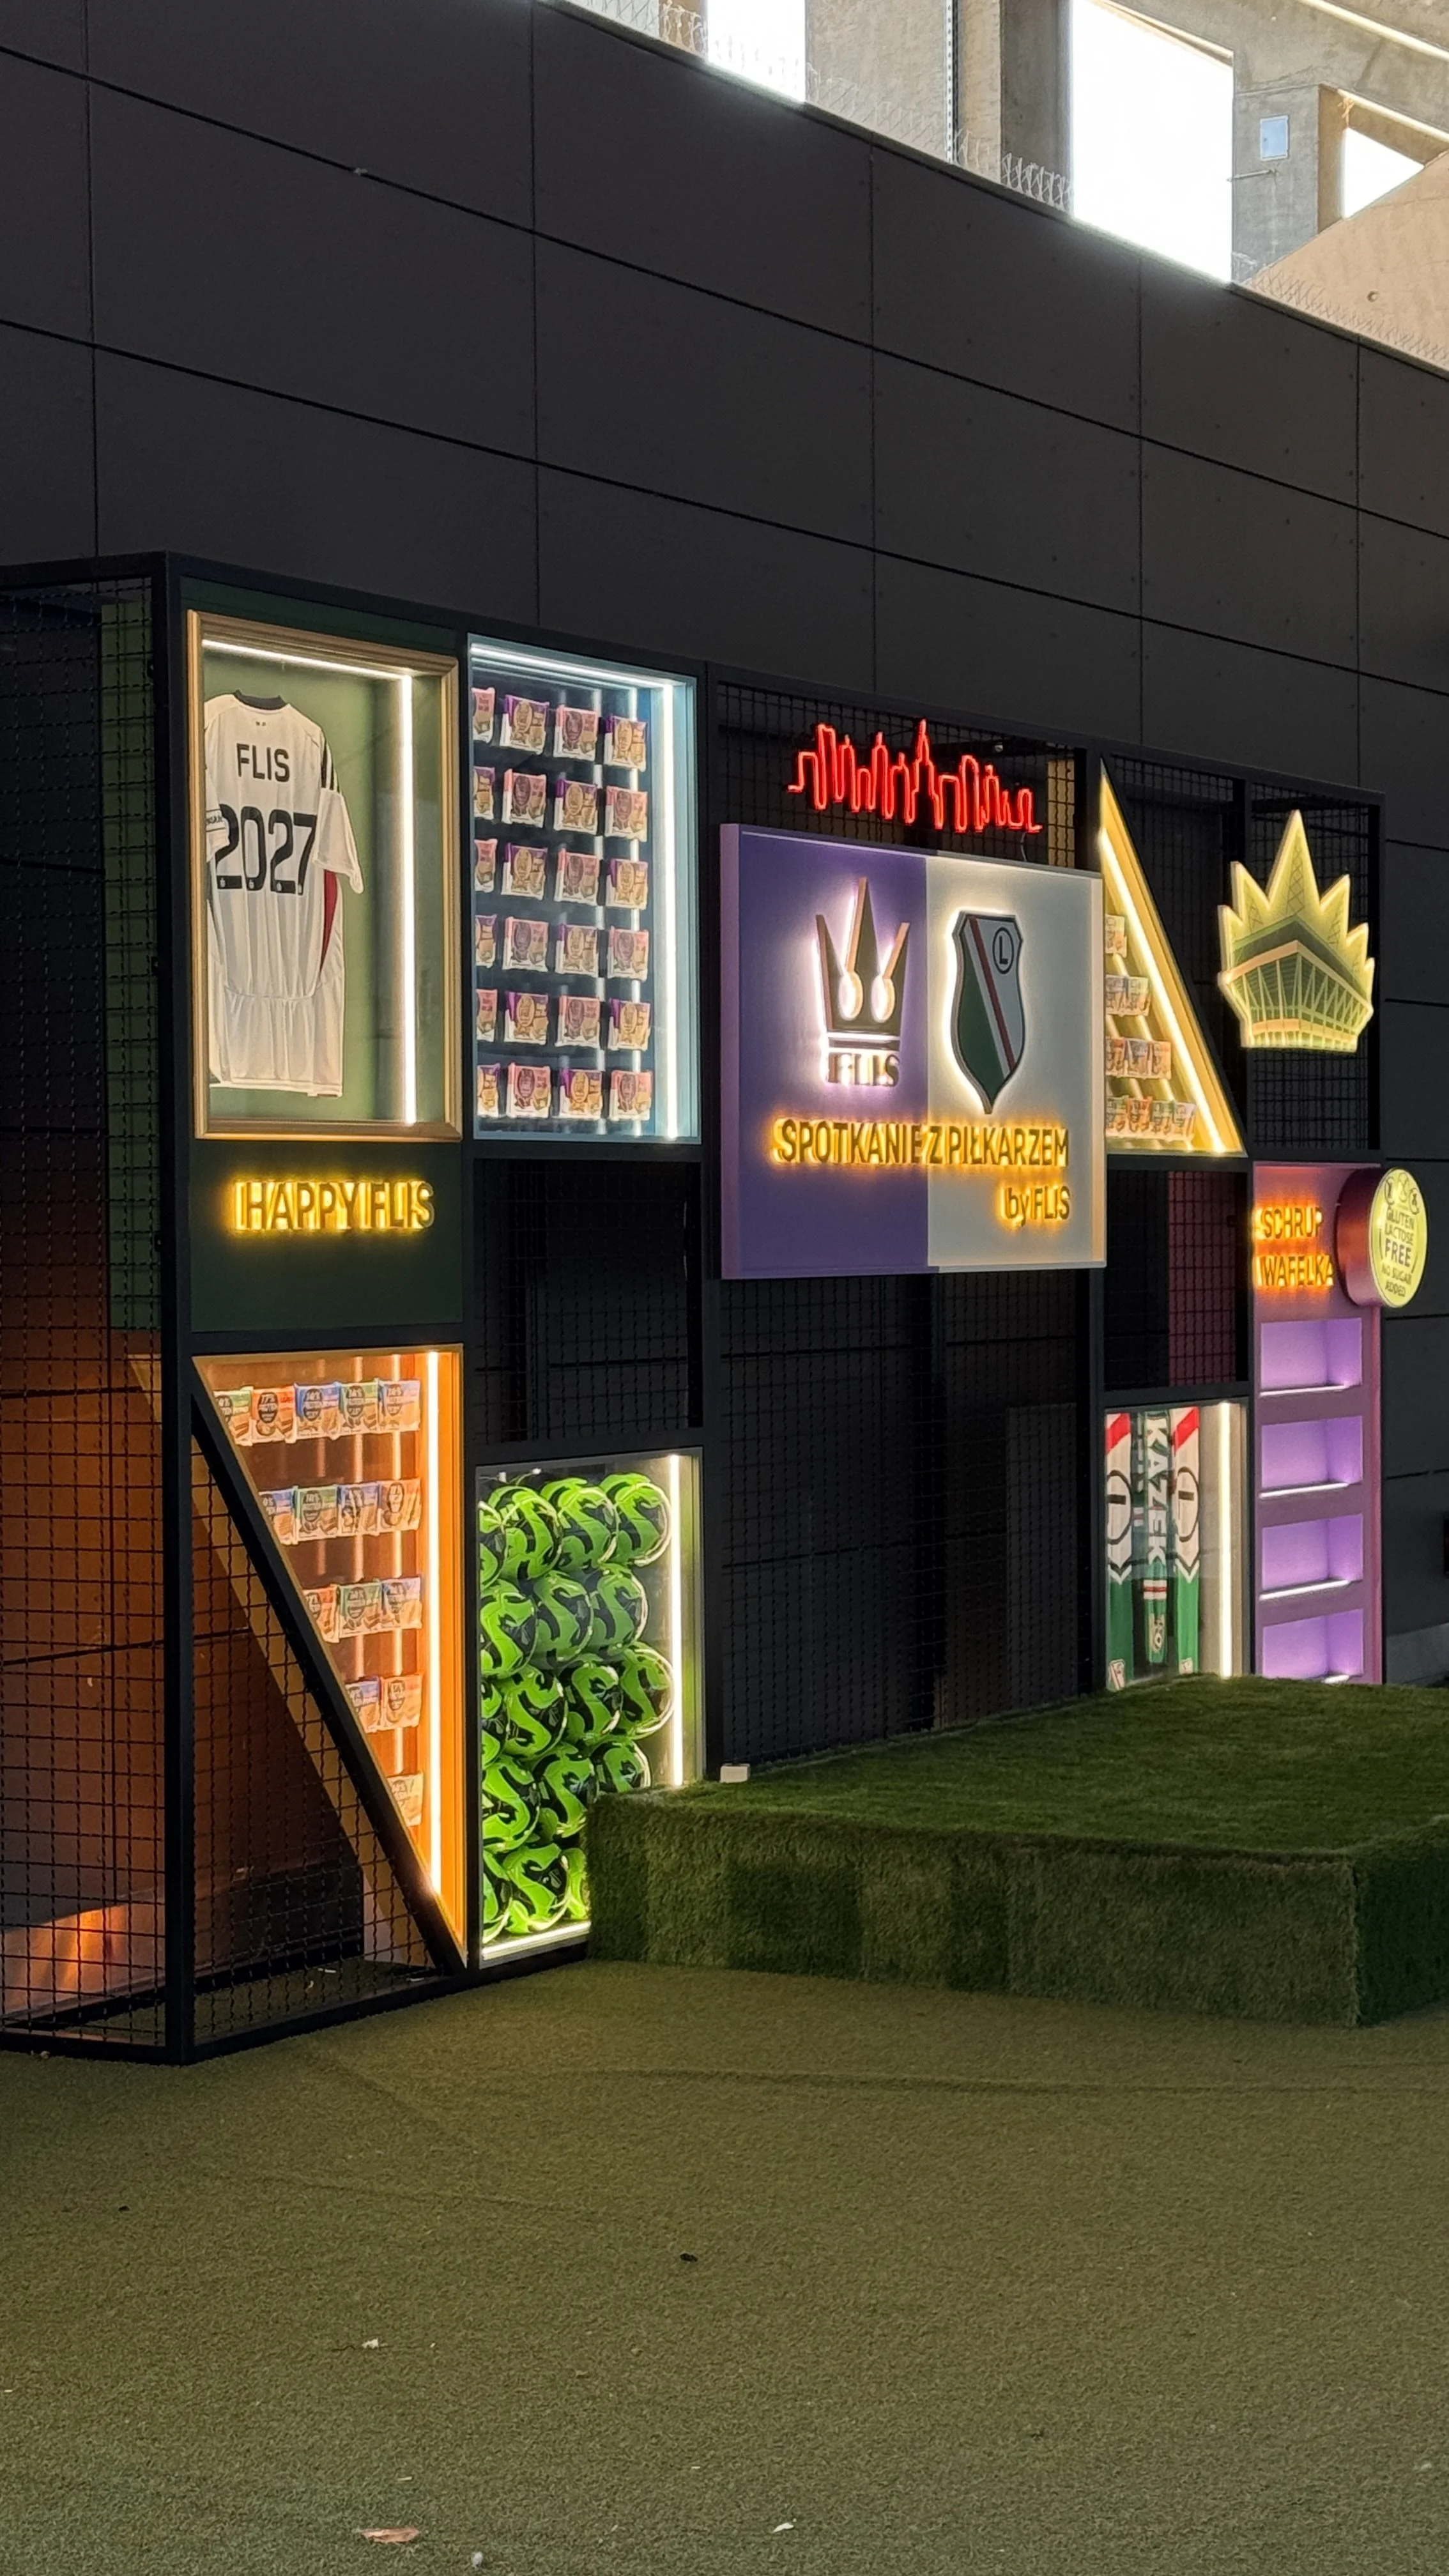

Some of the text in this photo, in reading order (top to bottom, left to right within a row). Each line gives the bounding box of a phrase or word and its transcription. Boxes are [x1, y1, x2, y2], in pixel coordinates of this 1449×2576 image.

[236, 742, 290, 783] FLIS
[214, 803, 318, 896] 2027
[828, 1052, 900, 1087] FLIS
[774, 1118, 923, 1163] SPOTKANIE
[1261, 1206, 1324, 1239] SCHRUP
[1259, 1254, 1335, 1287] WAFELKA
[1384, 1238, 1411, 1268] FREE
